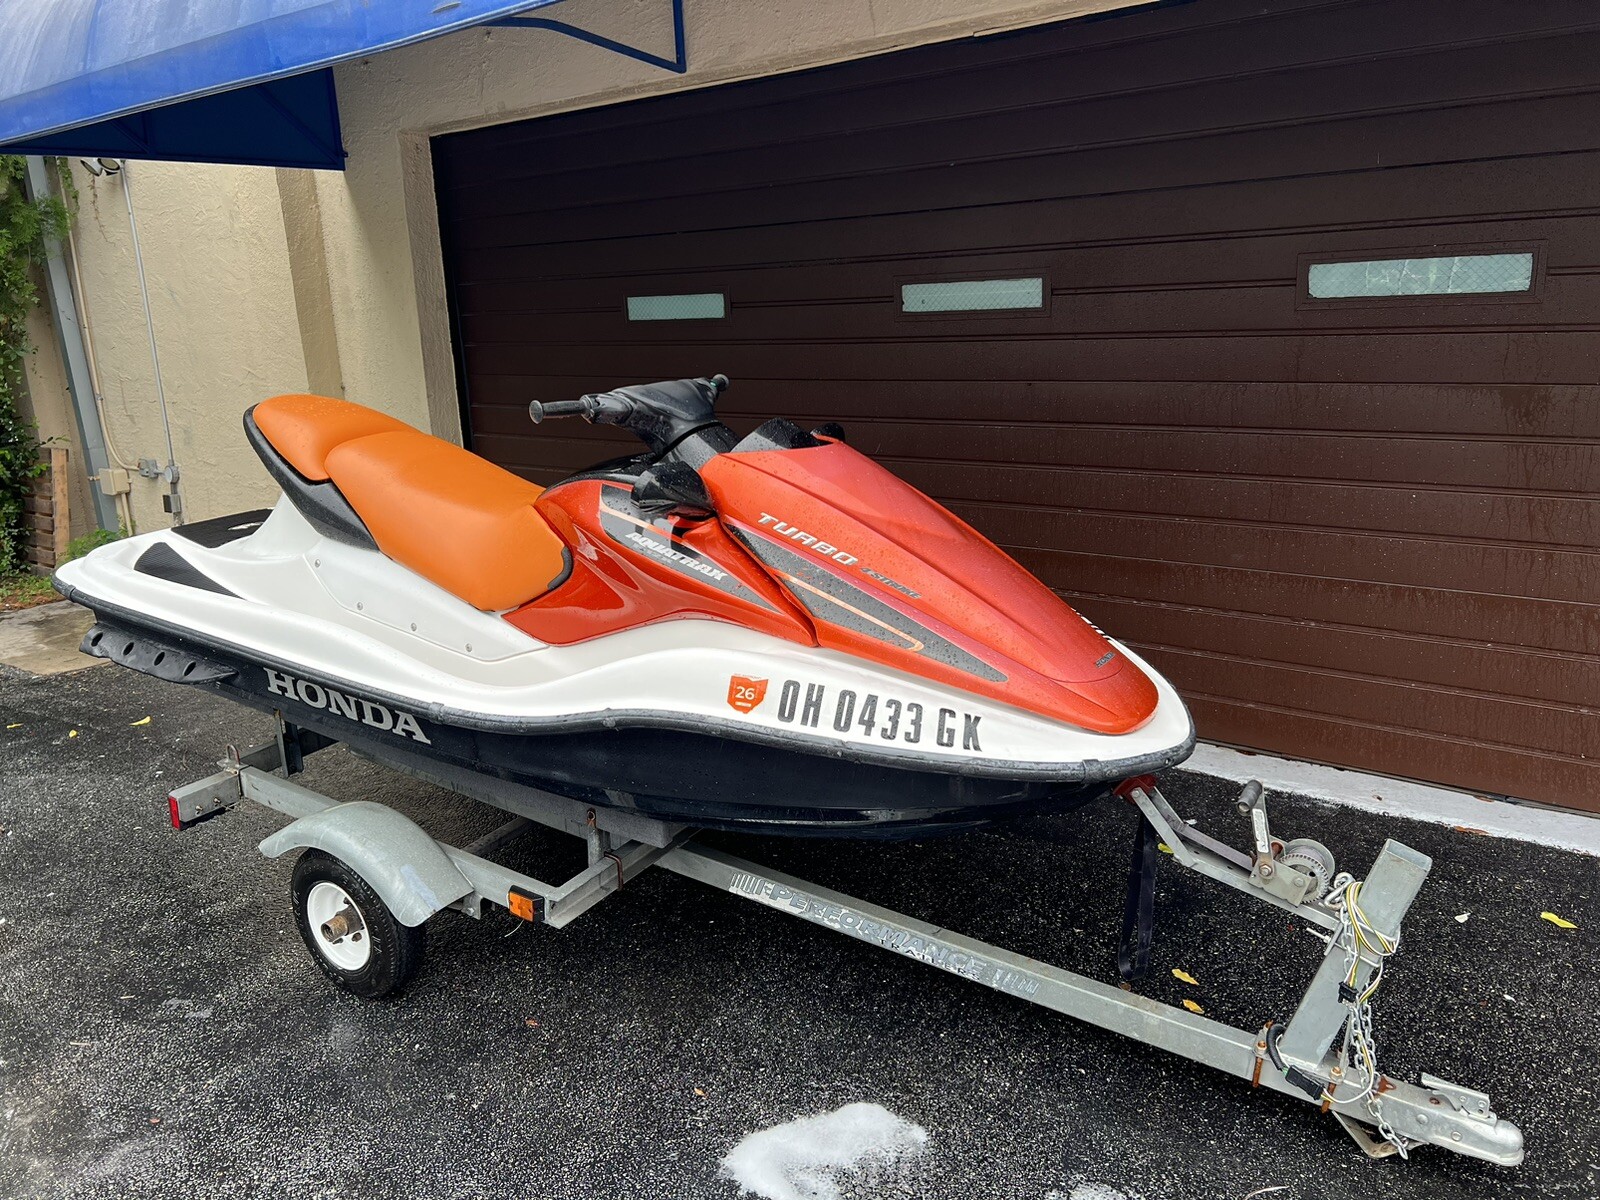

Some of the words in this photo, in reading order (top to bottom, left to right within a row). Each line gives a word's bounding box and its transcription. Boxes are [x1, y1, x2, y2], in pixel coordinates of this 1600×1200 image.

[625, 532, 728, 580] AQUATRAX
[757, 512, 859, 566] TURBO
[263, 667, 432, 745] HONDA
[735, 685, 755, 700] 26
[777, 679, 826, 728] OH
[833, 689, 924, 743] 0433
[936, 707, 983, 752] GK
[768, 883, 987, 976] PERFORMANCE
